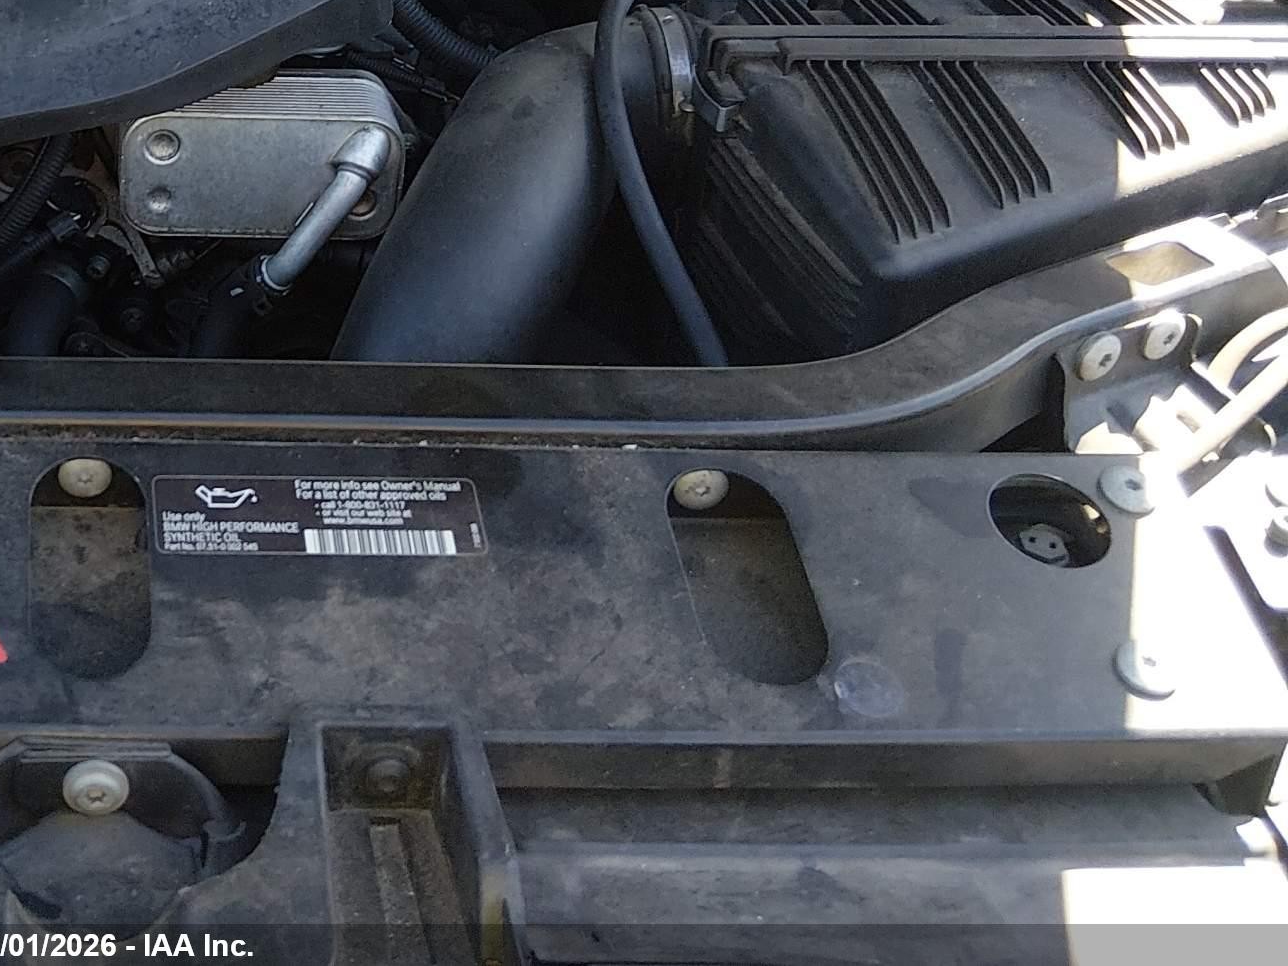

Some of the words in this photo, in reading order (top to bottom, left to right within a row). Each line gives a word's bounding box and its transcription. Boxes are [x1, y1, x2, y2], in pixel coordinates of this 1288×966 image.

[295, 479, 312, 489] For
[313, 481, 339, 490] more
[341, 480, 360, 490] info
[362, 482, 379, 490] see
[381, 480, 422, 491] Owner's
[423, 481, 461, 492] Manual
[296, 489, 312, 499] For
[314, 491, 322, 499] a
[323, 490, 338, 499] list
[339, 490, 350, 499] of
[351, 490, 378, 500] other
[380, 490, 427, 501] approved
[428, 491, 447, 501] oils
[321, 501, 336, 509] call
[162, 511, 182, 521] Use
[183, 512, 206, 522] only
[163, 521, 191, 532] BMW
[192, 521, 218, 532] HIGH
[220, 521, 299, 533] PERFORMANCE
[163, 532, 222, 542] SYNTHETIC
[223, 533, 241, 542] OIL
